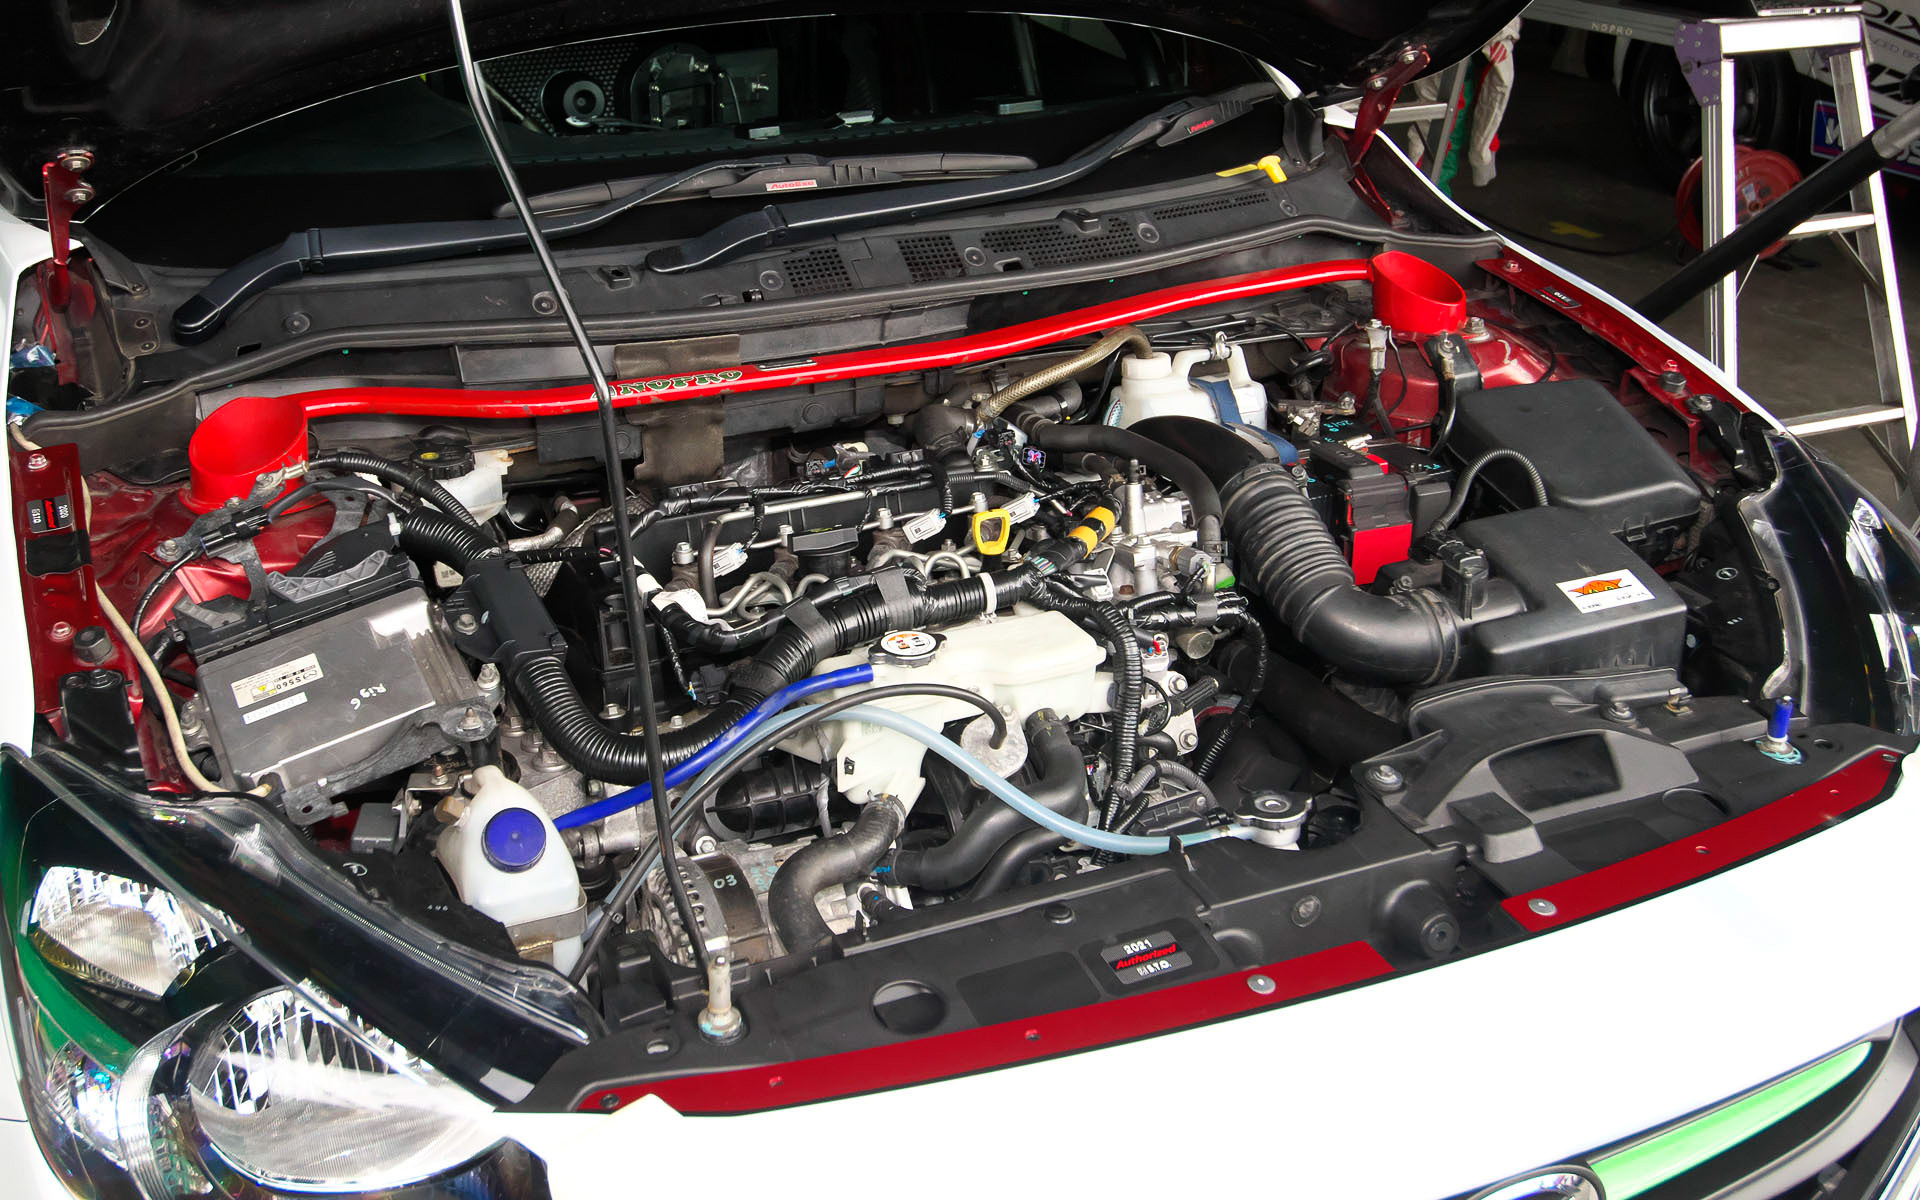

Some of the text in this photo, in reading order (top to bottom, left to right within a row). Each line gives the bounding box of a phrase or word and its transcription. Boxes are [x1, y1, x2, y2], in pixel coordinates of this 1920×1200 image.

[1592, 23, 1632, 36] NOPRO
[617, 370, 743, 395] NOPRO
[1115, 943, 1177, 970] Authorized
[1123, 938, 1153, 955] 2021
